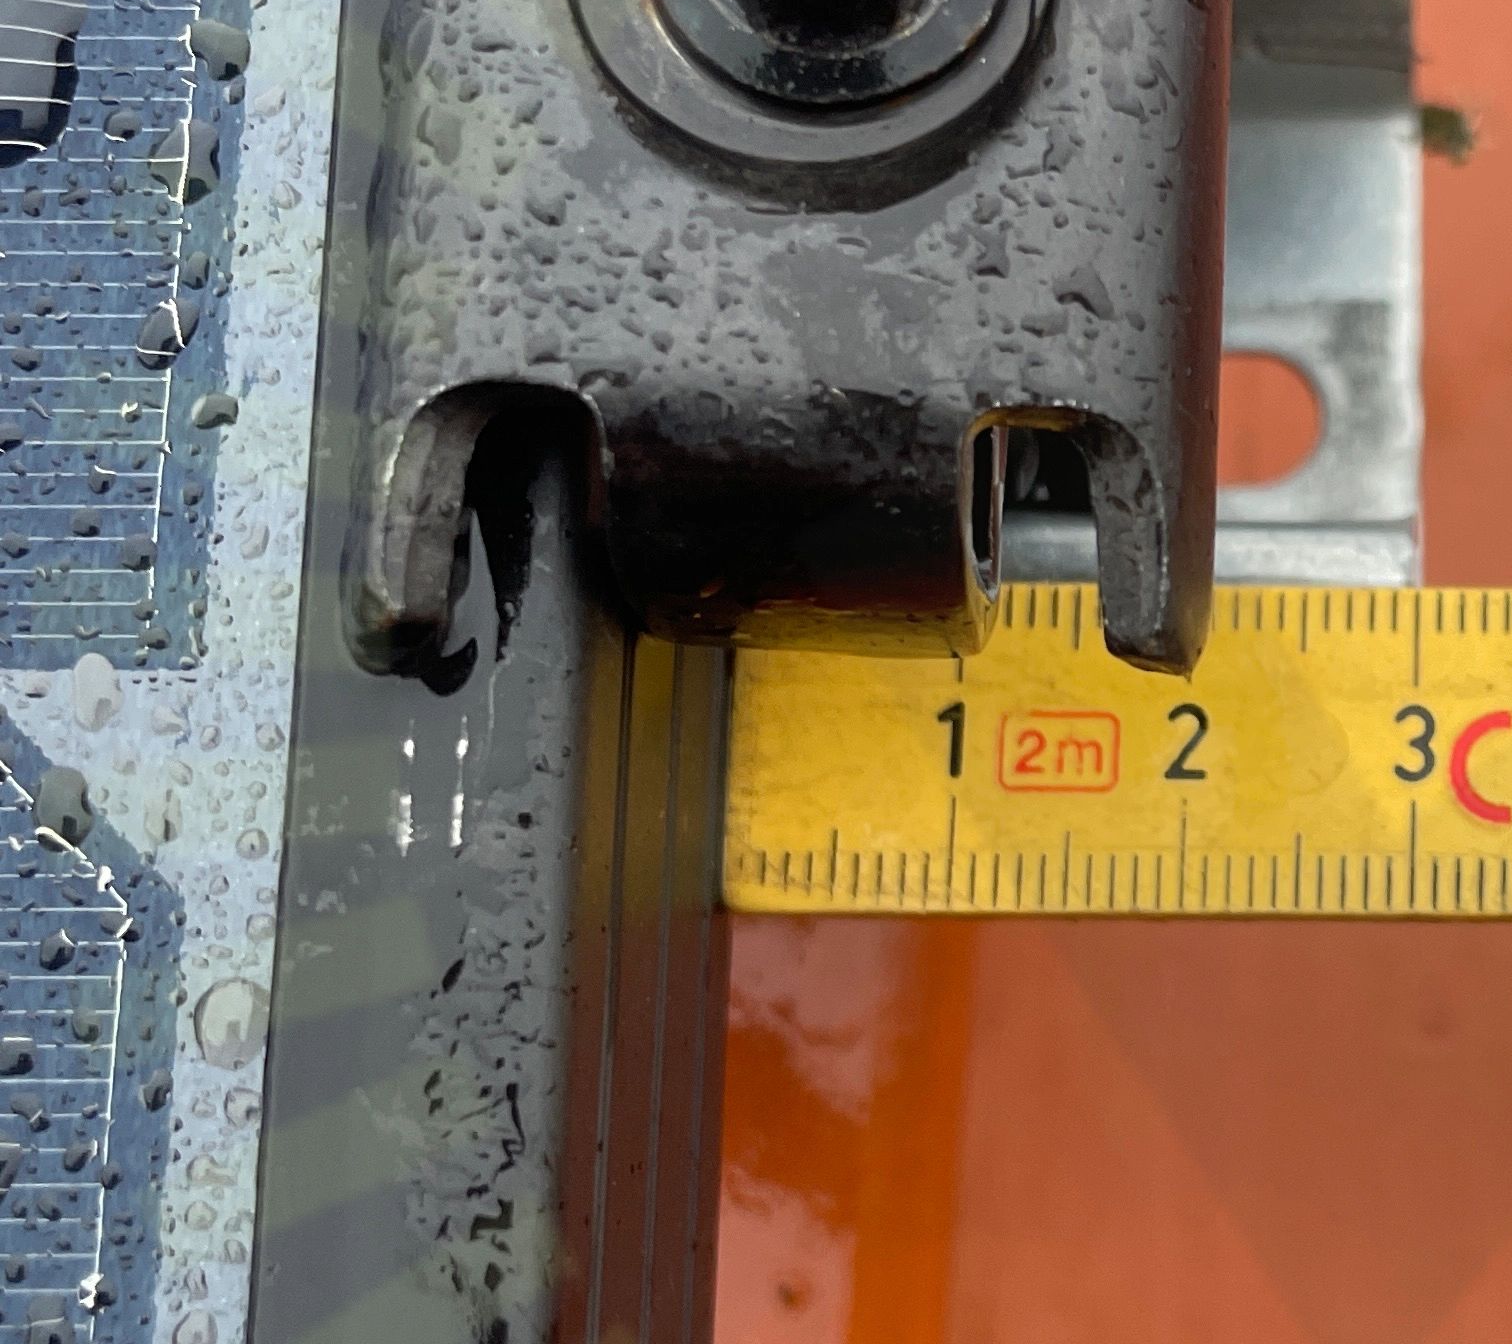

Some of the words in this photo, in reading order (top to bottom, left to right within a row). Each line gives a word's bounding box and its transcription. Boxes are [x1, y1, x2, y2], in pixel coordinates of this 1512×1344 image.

[938, 702, 965, 778] 1
[1165, 704, 1209, 780] 2
[1395, 705, 1436, 782] 3
